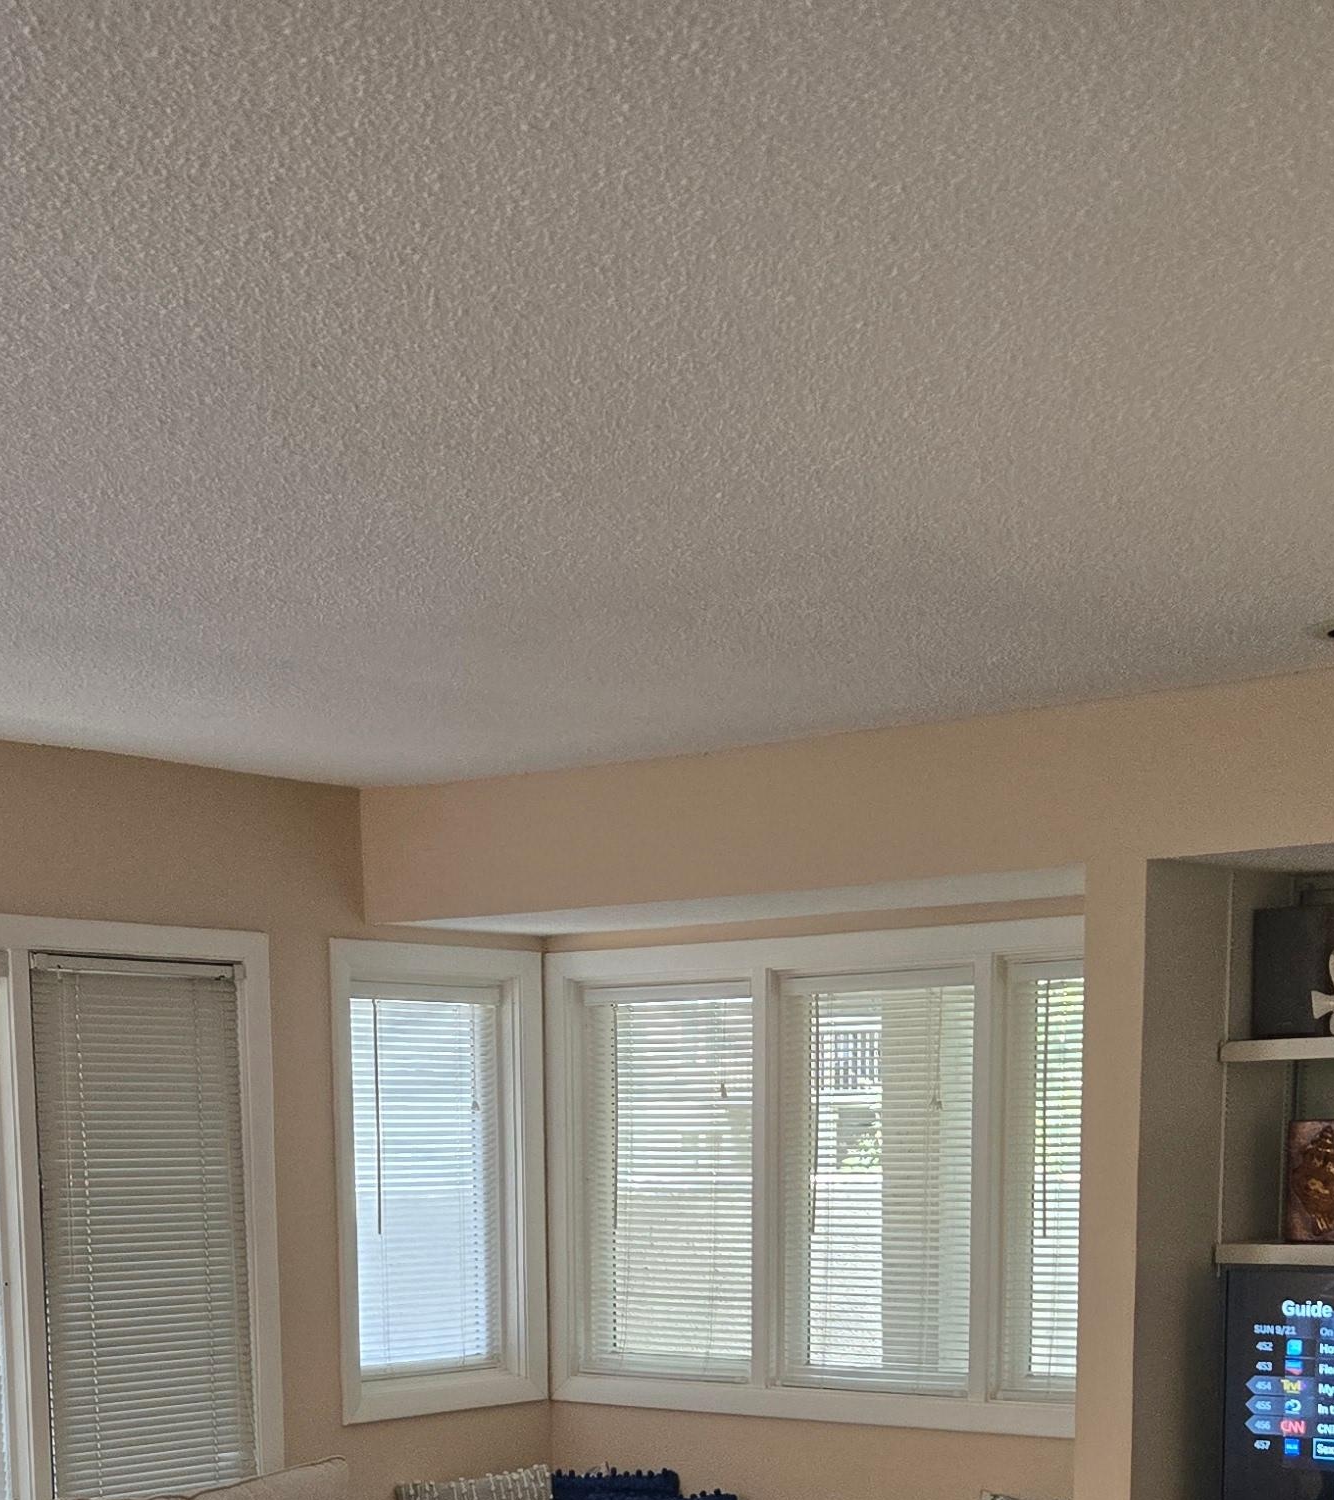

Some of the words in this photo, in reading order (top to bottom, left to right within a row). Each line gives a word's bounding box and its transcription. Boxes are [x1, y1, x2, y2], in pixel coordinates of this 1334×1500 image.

[1282, 1300, 1333, 1318] Guide
[1254, 1324, 1274, 1336] SUN
[1320, 1327, 1332, 1337] On
[1317, 1404, 1329, 1415] In
[1280, 1420, 1305, 1434] CNN
[1317, 1443, 1334, 1455] Sex
